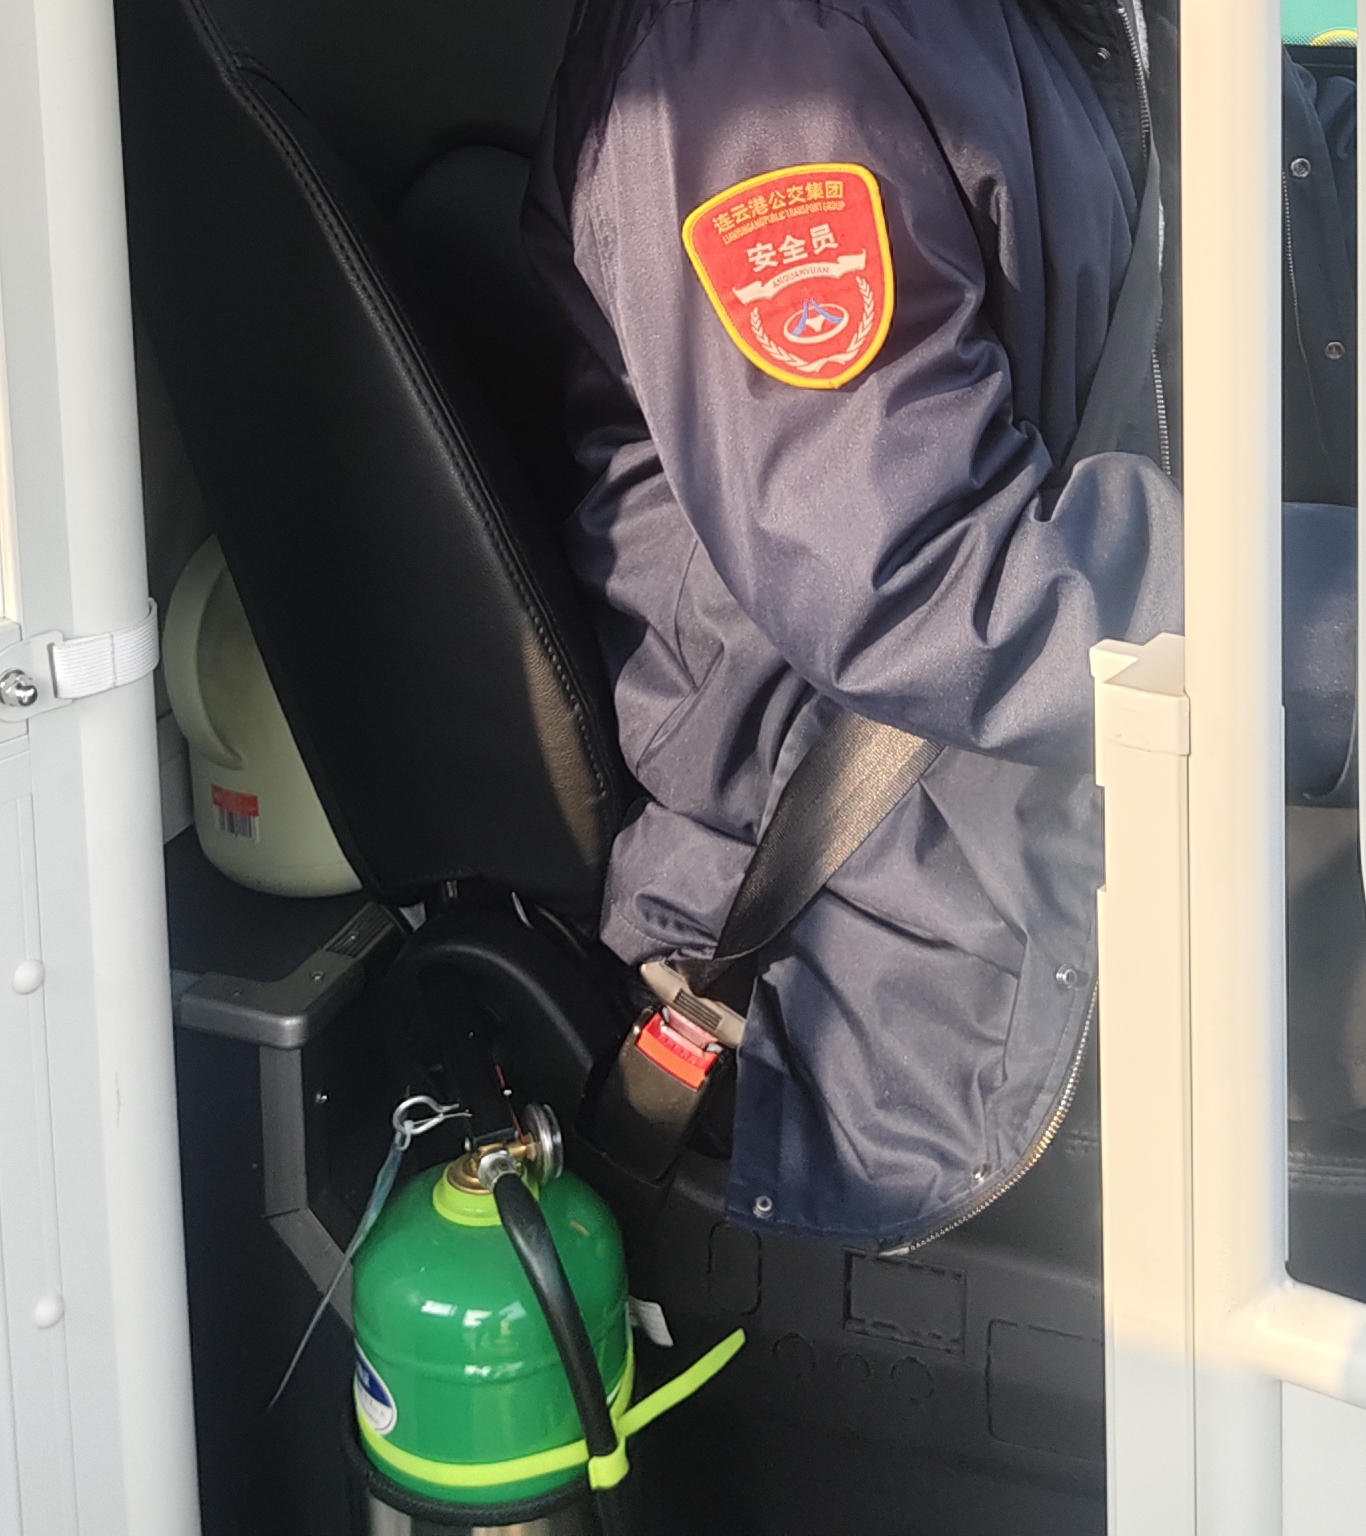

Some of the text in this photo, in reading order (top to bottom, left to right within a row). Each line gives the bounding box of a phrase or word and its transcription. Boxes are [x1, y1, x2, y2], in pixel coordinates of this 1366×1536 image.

[712, 180, 844, 234] 连云港公交集团
[746, 223, 839, 273] 安全员
